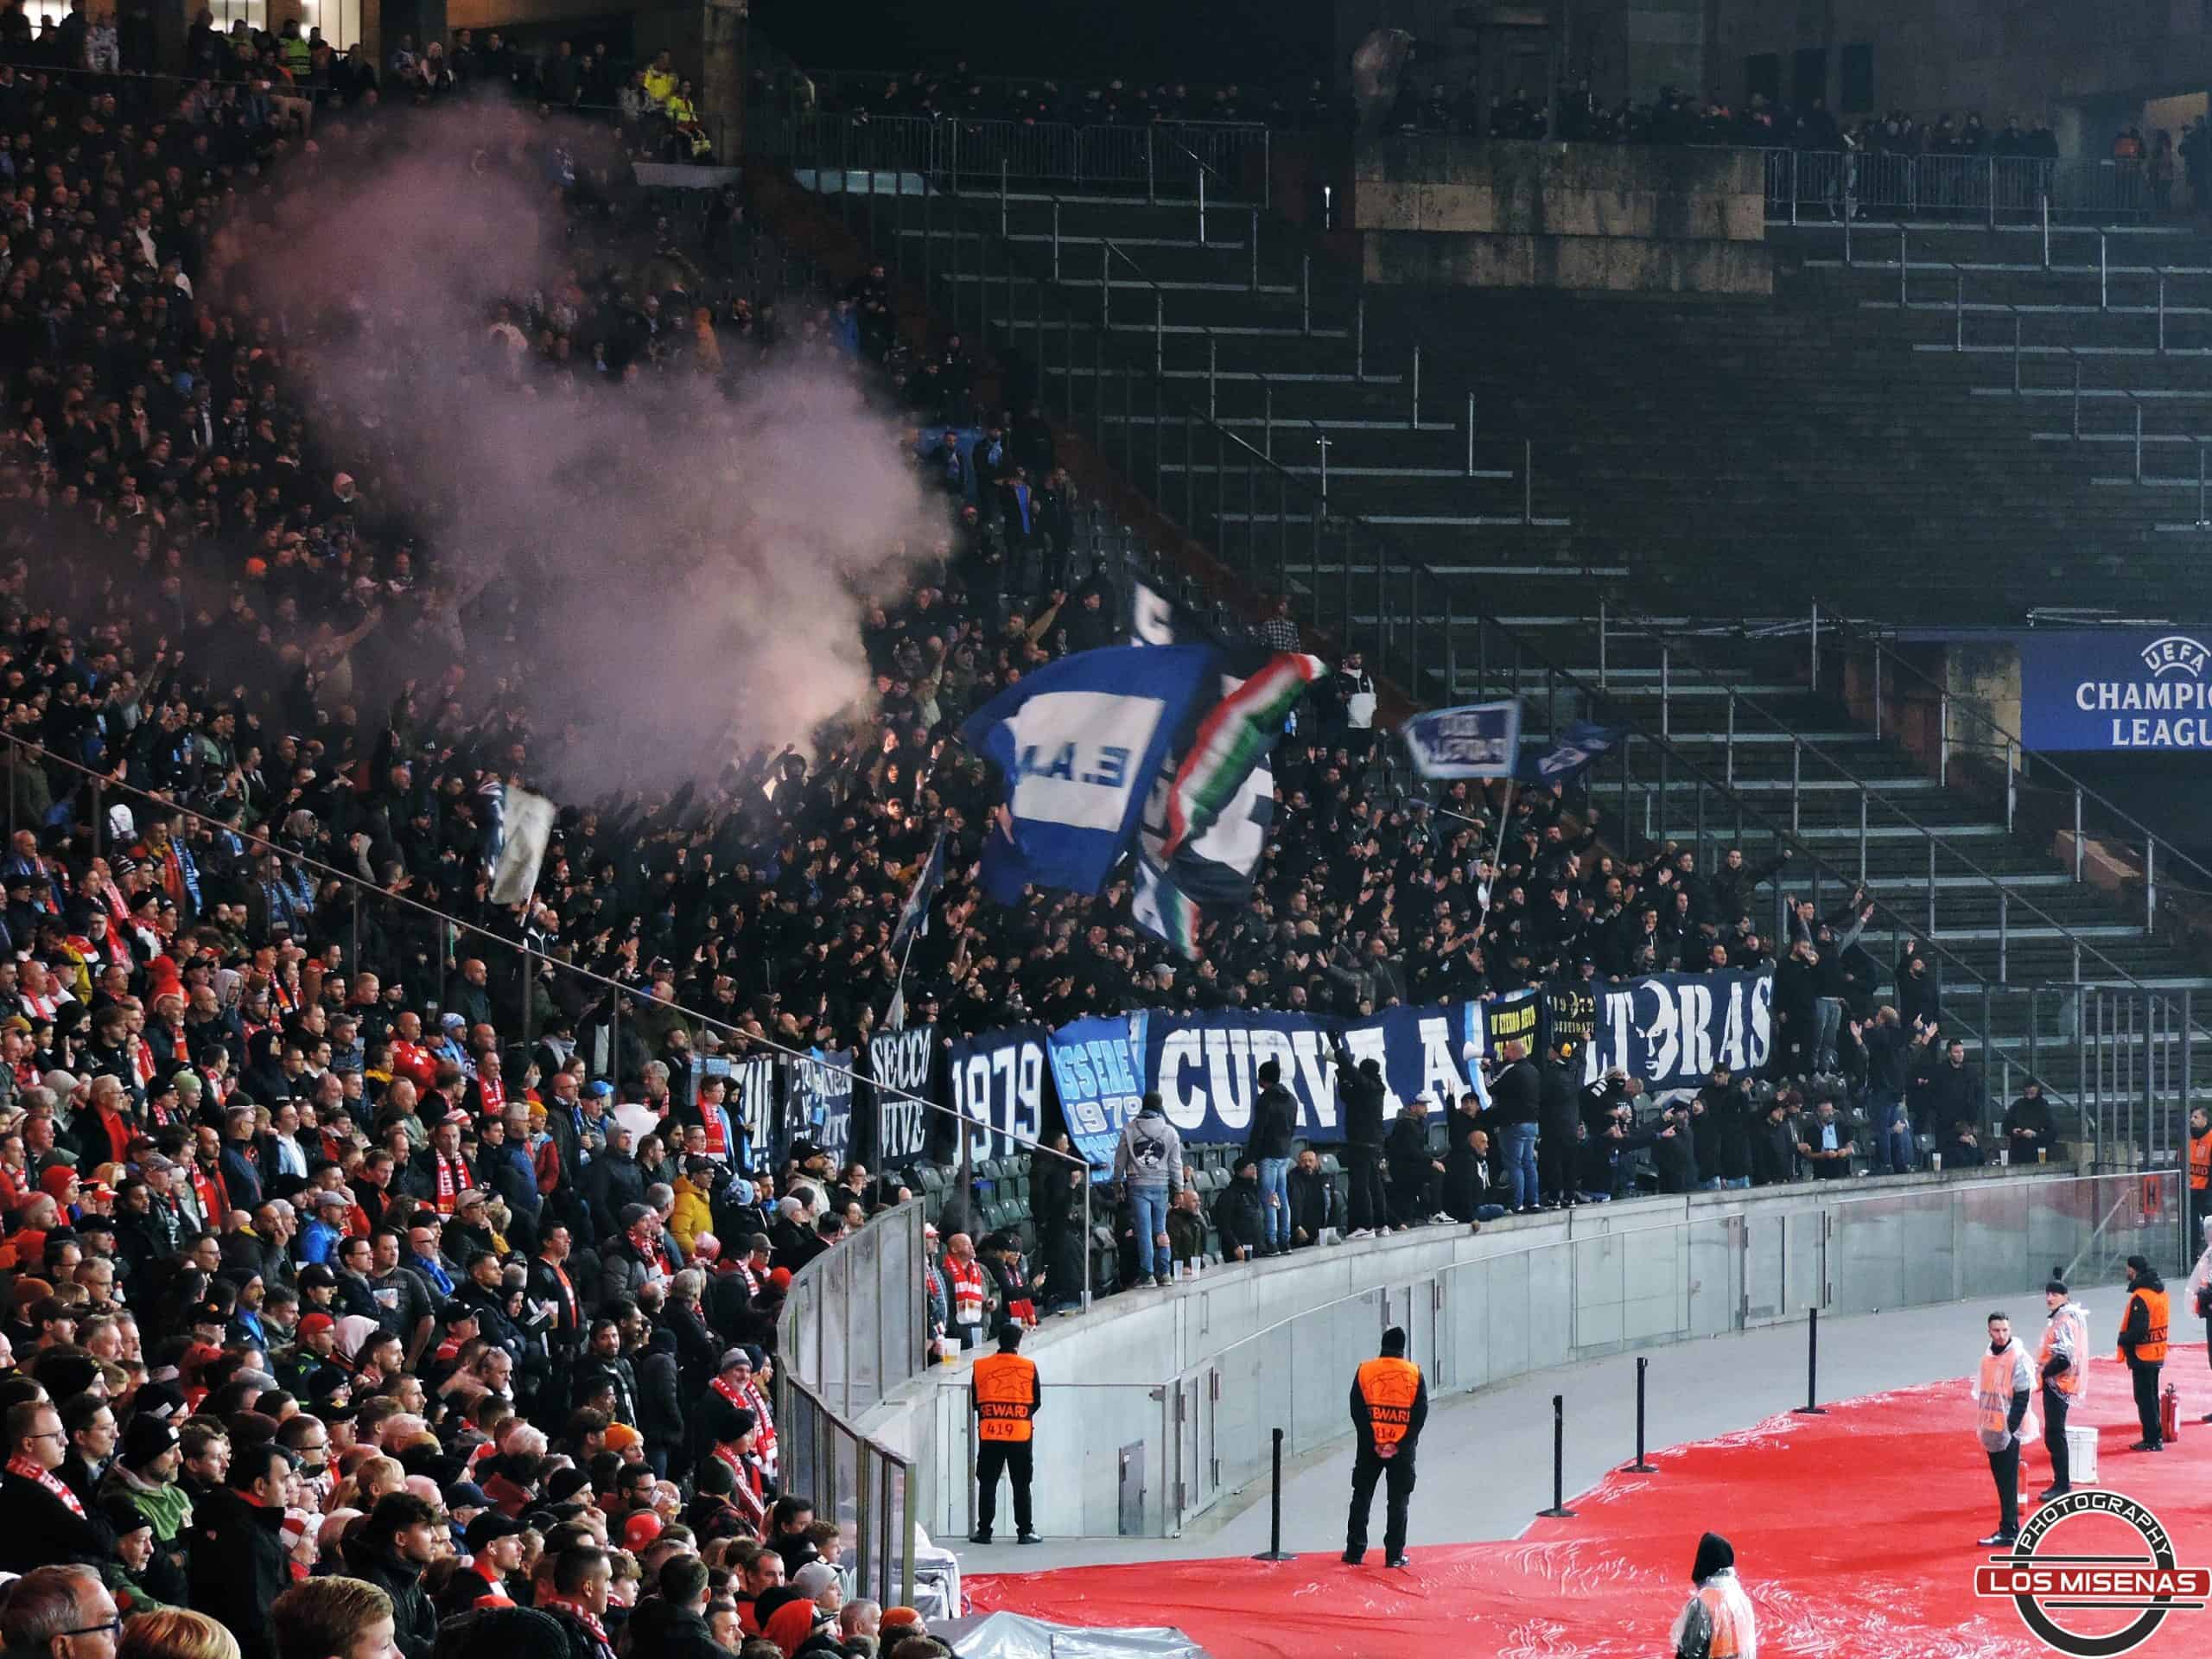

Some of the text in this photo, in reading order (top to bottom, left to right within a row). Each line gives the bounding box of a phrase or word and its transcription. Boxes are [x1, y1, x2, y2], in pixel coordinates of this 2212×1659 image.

[2145, 643, 2204, 671] UEFA
[2075, 683, 2212, 711] CHAMPI
[952, 1043, 1044, 1168] 1979
[987, 1423, 1014, 1436] 419
